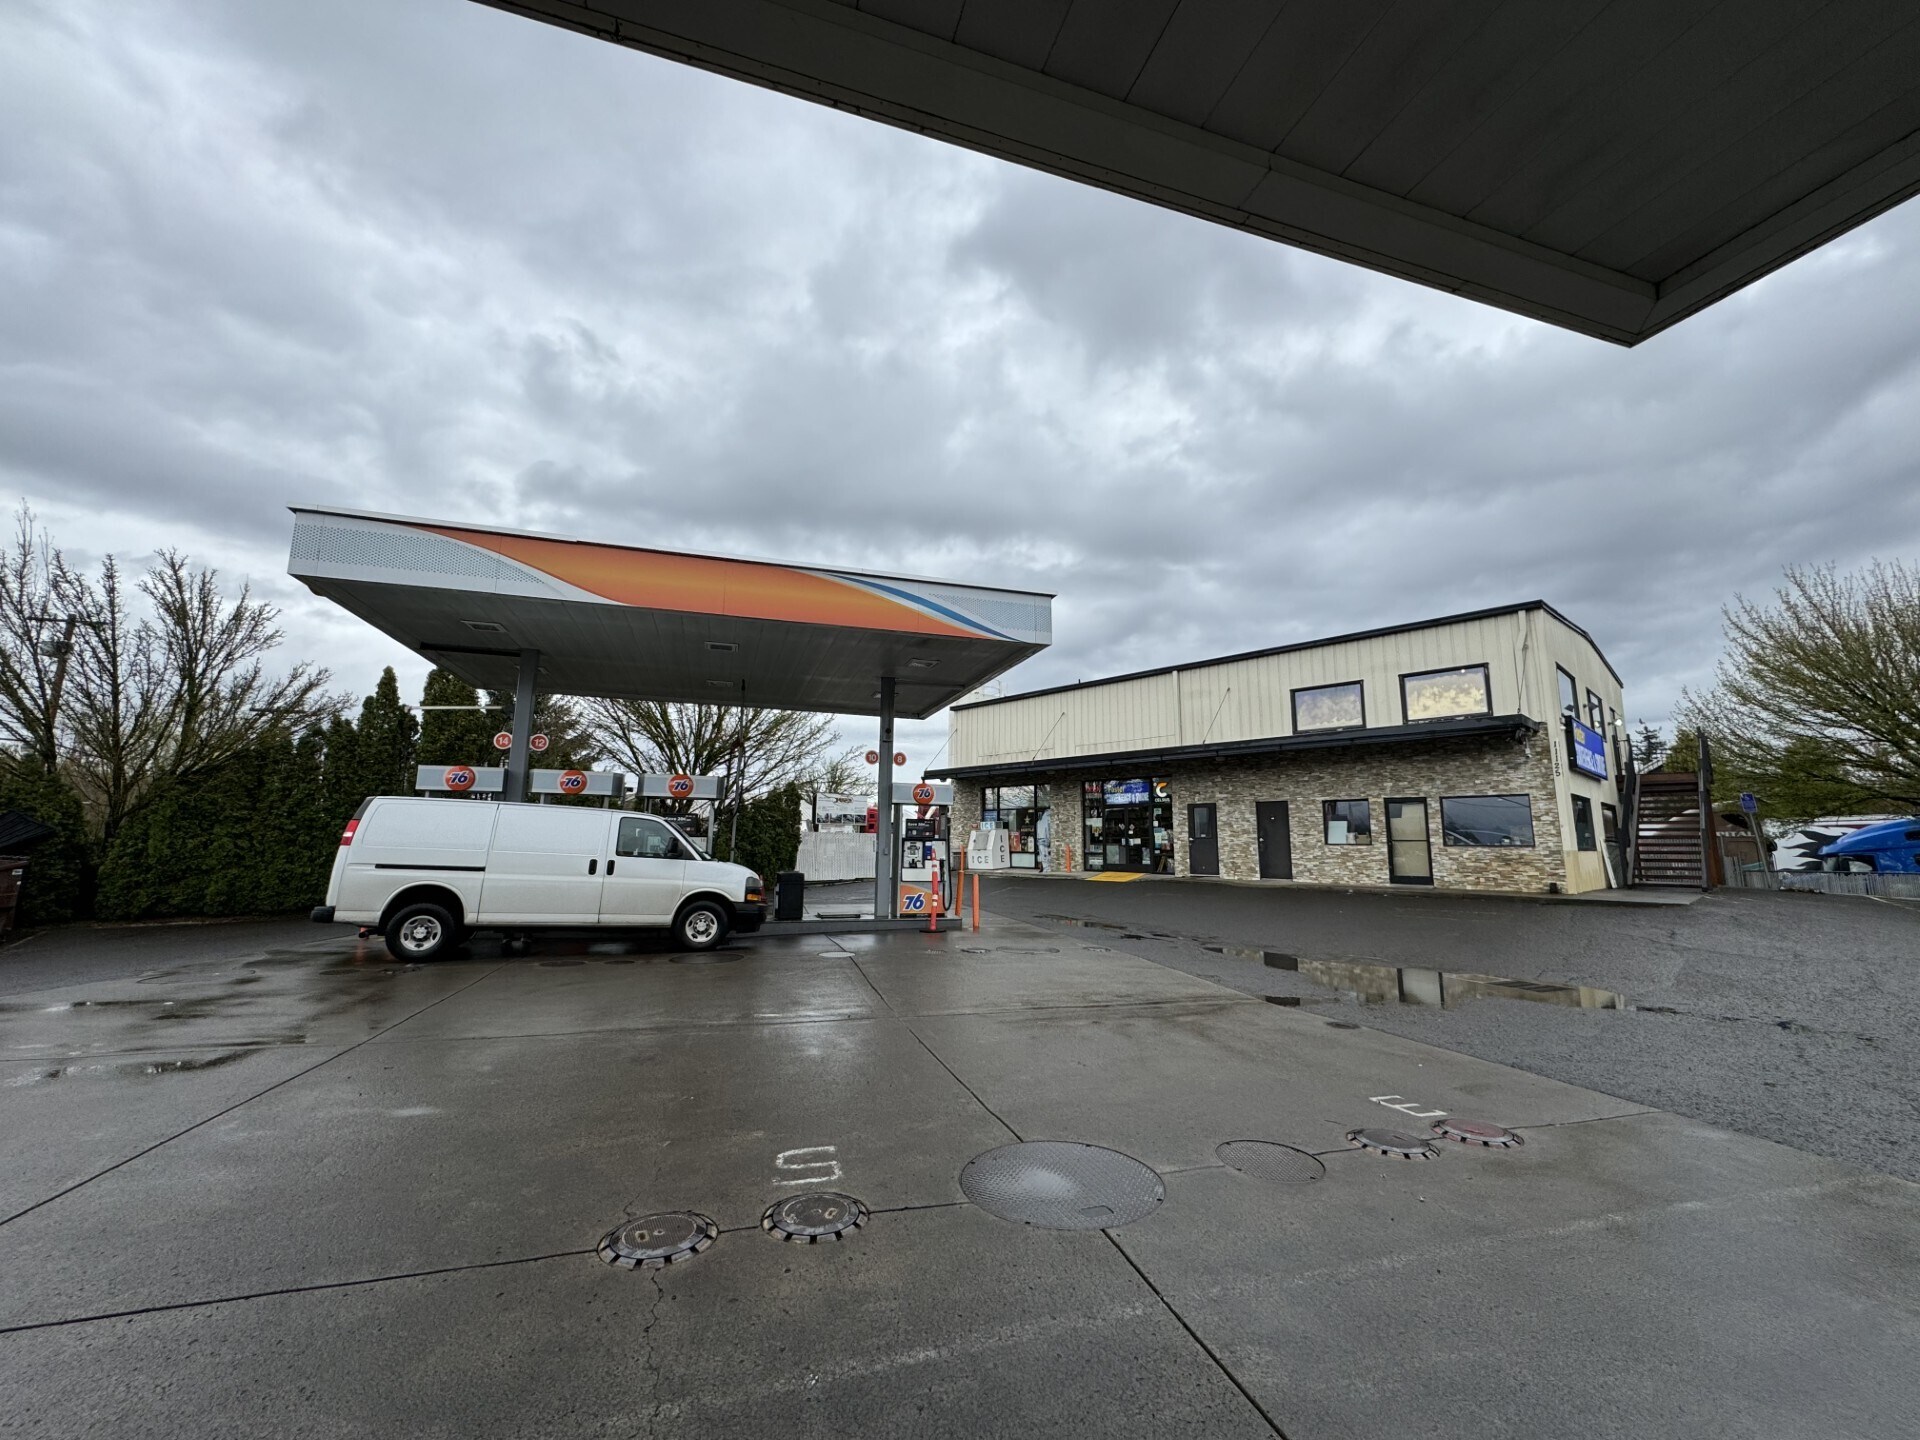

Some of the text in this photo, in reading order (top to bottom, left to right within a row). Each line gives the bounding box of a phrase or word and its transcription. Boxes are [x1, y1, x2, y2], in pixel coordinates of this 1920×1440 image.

[497, 736, 510, 746] 14
[533, 738, 546, 748] 12
[867, 753, 877, 762] 10
[896, 755, 903, 763] 8
[447, 769, 470, 786] 76
[562, 774, 583, 790] 76
[671, 778, 691, 792] 76
[917, 787, 932, 799] 76
[971, 855, 990, 864] ICE
[903, 892, 926, 911] 76
